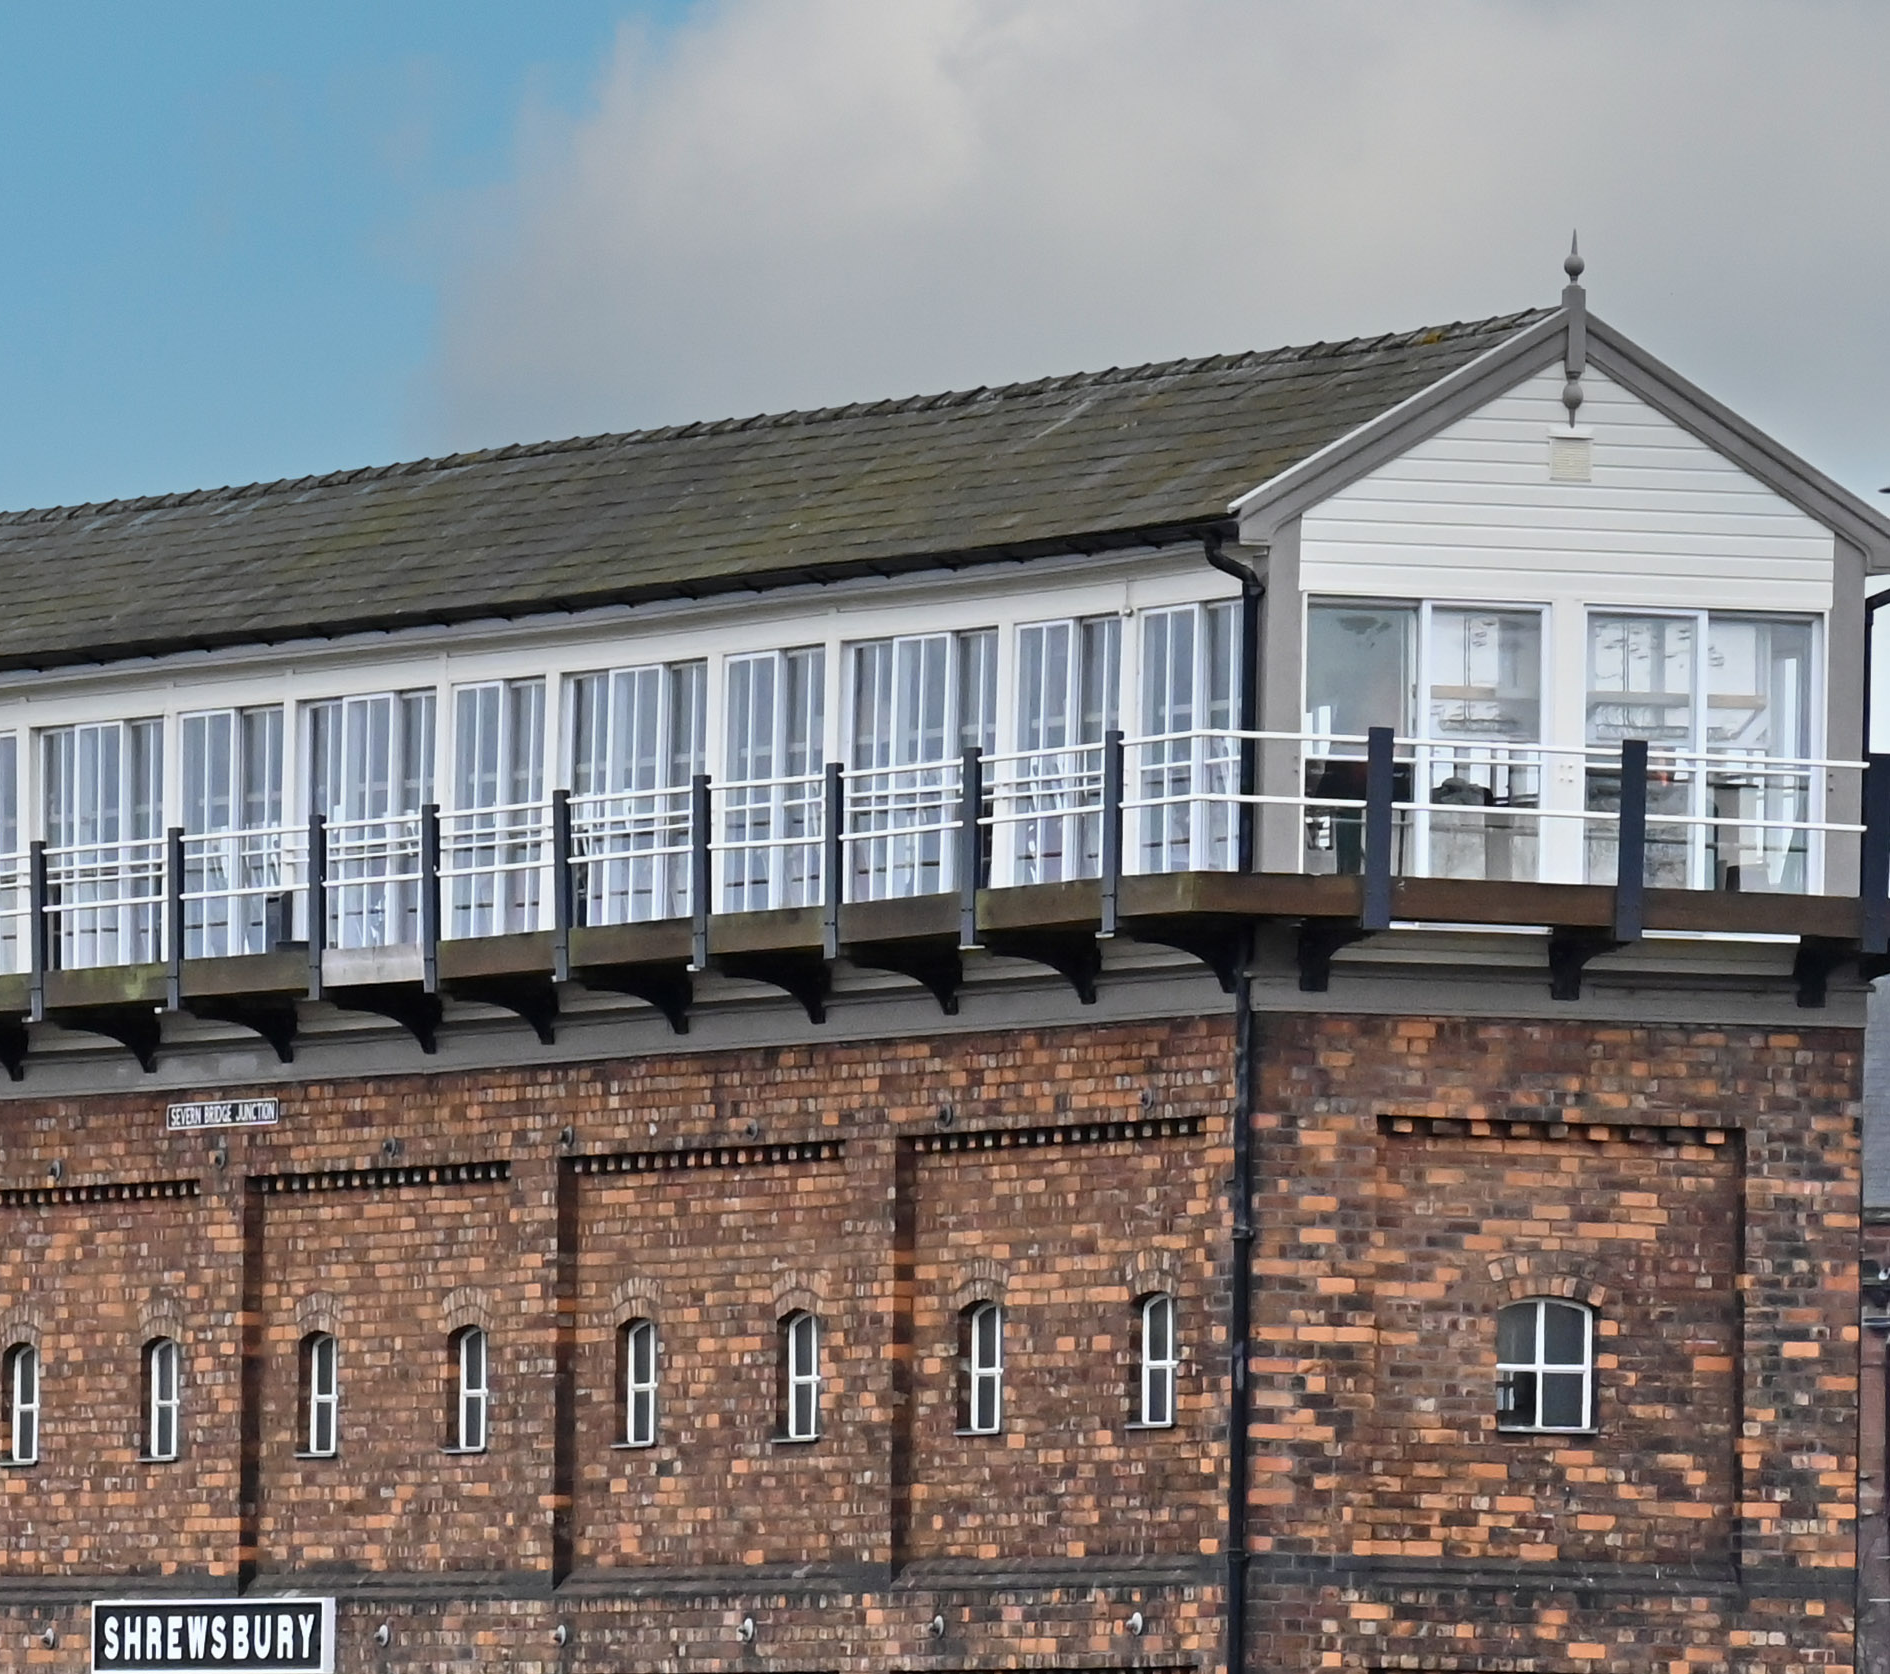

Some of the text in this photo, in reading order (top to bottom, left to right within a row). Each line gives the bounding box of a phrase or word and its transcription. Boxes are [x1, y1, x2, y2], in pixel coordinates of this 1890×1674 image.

[171, 1102, 275, 1127] SEVERN BRIDGE JUNCTION
[103, 1613, 315, 1660] SHREWSBURY
